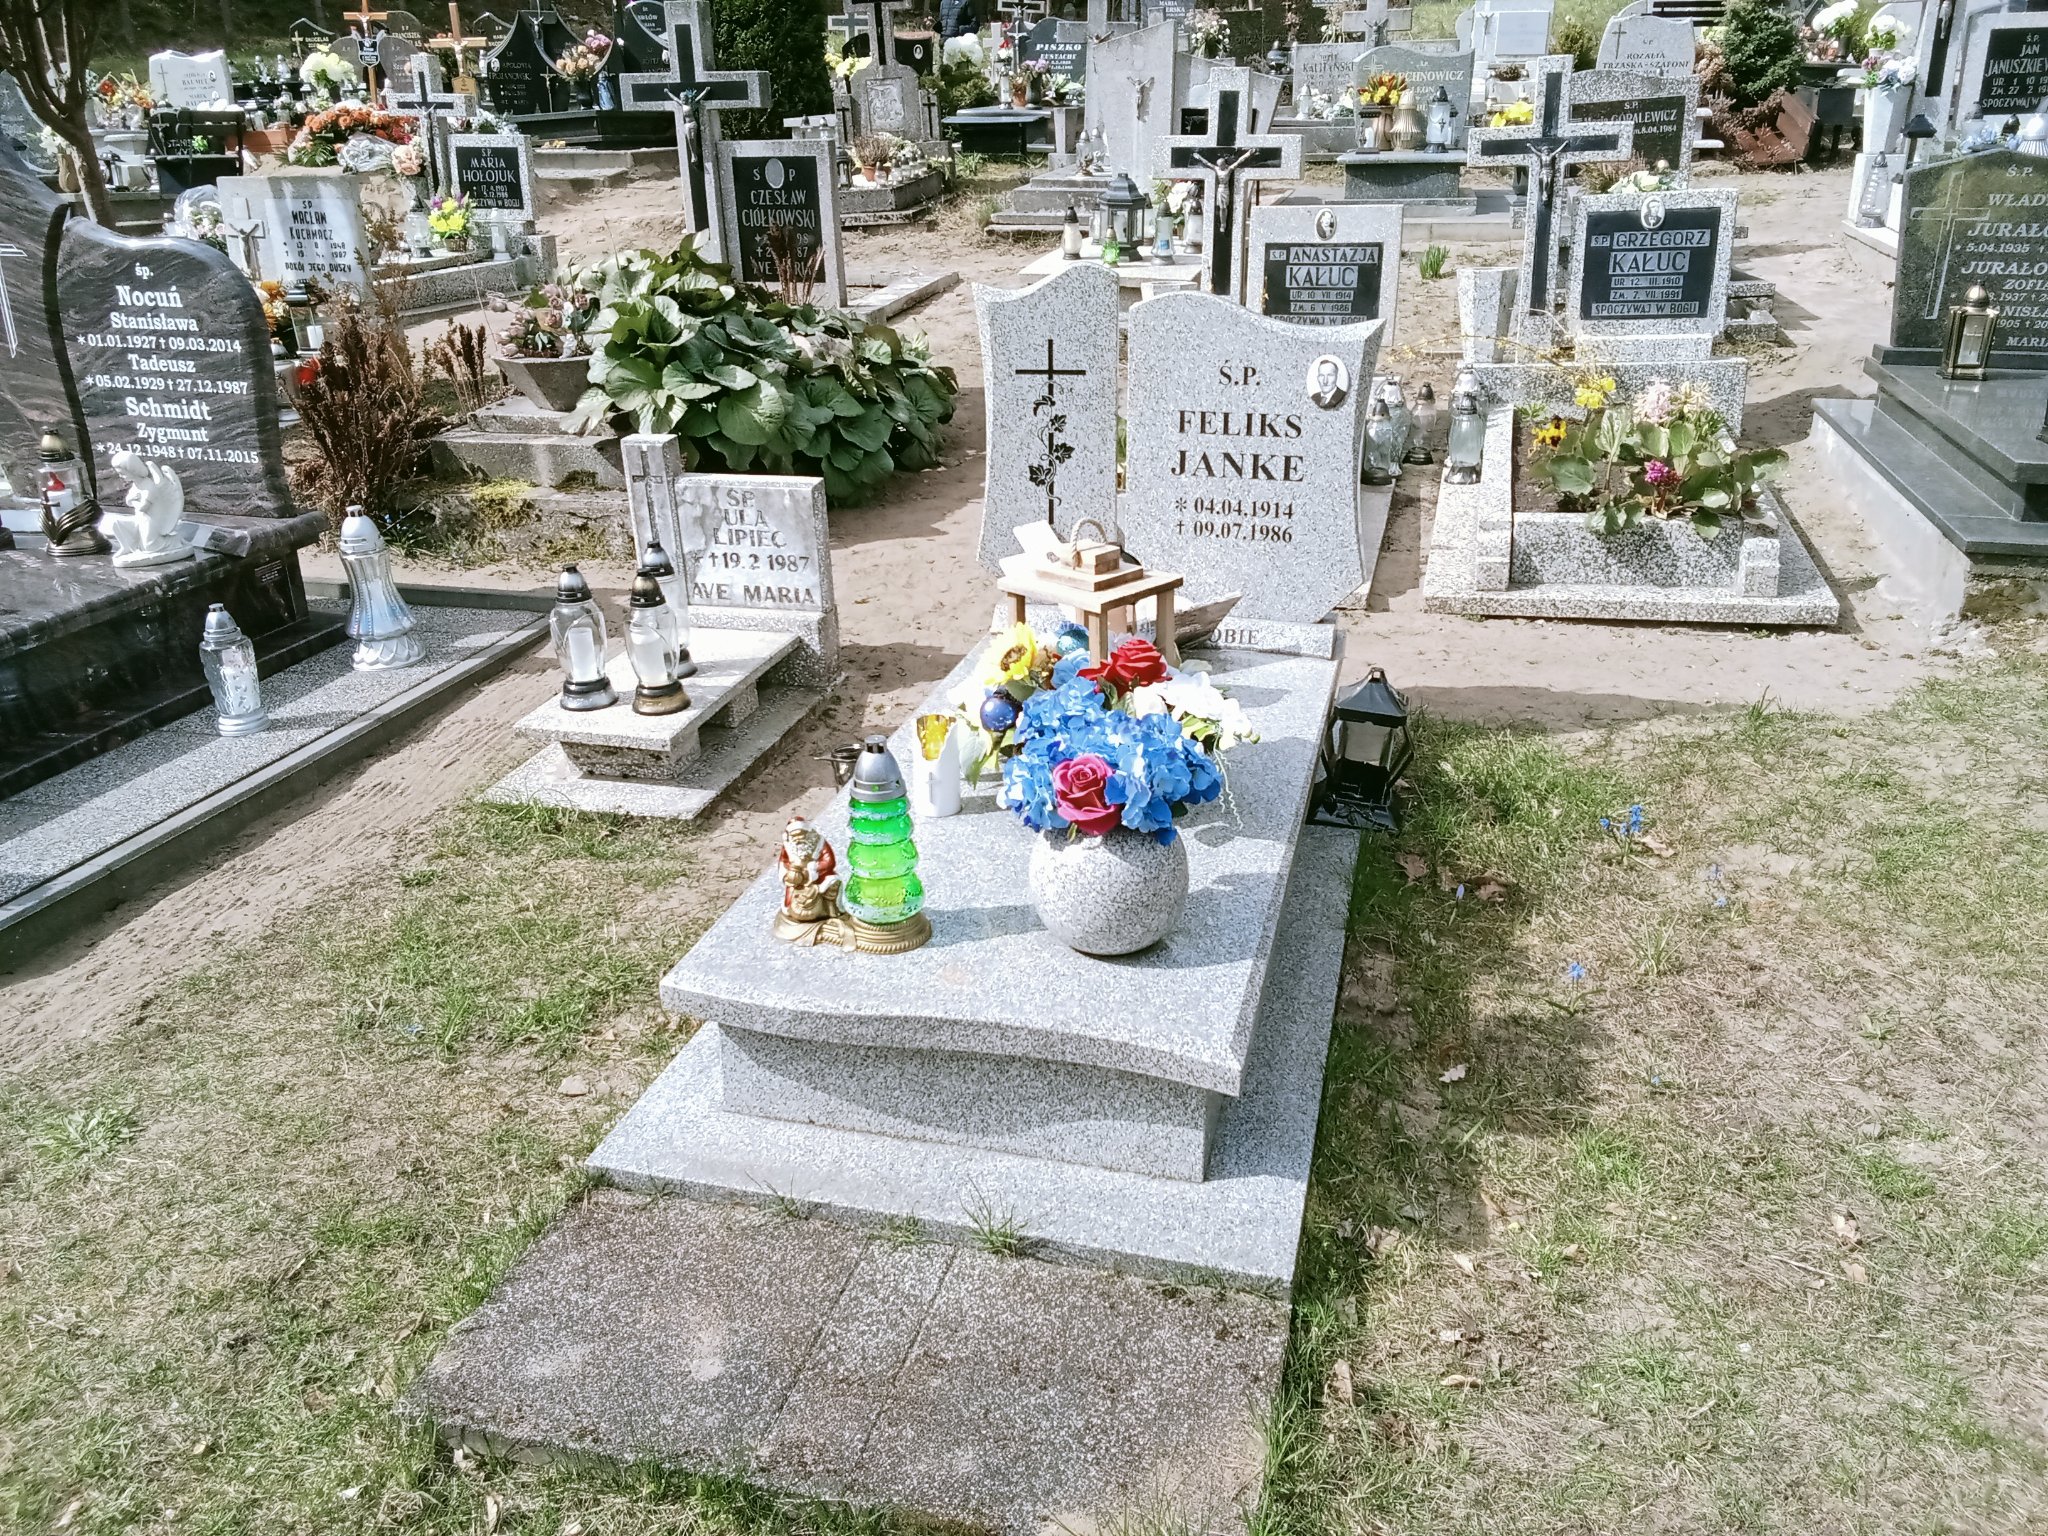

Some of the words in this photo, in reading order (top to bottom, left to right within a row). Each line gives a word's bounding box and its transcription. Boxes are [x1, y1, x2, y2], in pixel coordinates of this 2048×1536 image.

[1035, 43, 1082, 51] PISZKO
[1626, 52, 1666, 60] ROZALIA
[2020, 44, 2040, 57] JAN
[2008, 86, 2020, 95] 27
[2027, 86, 2034, 94] 2
[1981, 97, 2030, 108] SPOCZYWAJ
[2032, 97, 2040, 105] W
[470, 157, 506, 169] MARIA
[462, 169, 517, 184] HOŁOJUK
[750, 189, 806, 206] CZESŁAW
[741, 207, 816, 230] CIÓŁKOWSKI
[289, 226, 334, 241] KUCHMACZ
[1616, 230, 1707, 248] GRZEGORZ
[1292, 248, 1378, 263] ANASTAZJA
[1611, 251, 1686, 273] KAŁUC
[135, 262, 154, 280] śp.
[308, 263, 326, 272] JEGO
[329, 263, 352, 273] DUSZY
[1289, 266, 1356, 287] KAŁUC
[1662, 276, 1681, 285] 1910
[115, 284, 183, 308] Nocuń
[1335, 291, 1352, 299] 1914
[1661, 290, 1680, 299] 1991
[1331, 303, 1350, 312] 1986
[1595, 303, 1652, 314] SPOCZYWAJ
[1656, 303, 1666, 314] W
[1669, 302, 1697, 314] BOGU
[110, 311, 200, 332] Stanisława
[1329, 316, 1337, 325] W
[87, 333, 156, 349] 01.01.1927
[169, 336, 242, 353] 09.03.2014
[127, 353, 196, 373] Tadeusz
[1218, 359, 1261, 386] Ś.P.
[95, 374, 165, 390] 05.02.1929
[177, 378, 248, 395] 27.12.1987
[125, 396, 213, 421] Schmidt
[136, 422, 210, 443] Zygmunt
[1178, 409, 1302, 439] FELIKS
[106, 442, 176, 458] 2412.1948
[187, 447, 259, 464] 07.11.2015
[1171, 450, 1304, 482] JANKE
[724, 508, 769, 527] ULA
[1194, 497, 1294, 520] 04.04.1914
[713, 527, 787, 548] LIPIEC
[1194, 520, 1292, 543] 09.07.1986
[767, 554, 810, 572] 1987
[691, 582, 731, 600] AVE
[743, 585, 816, 604] MARIA
[1208, 628, 1260, 646] OBIE
